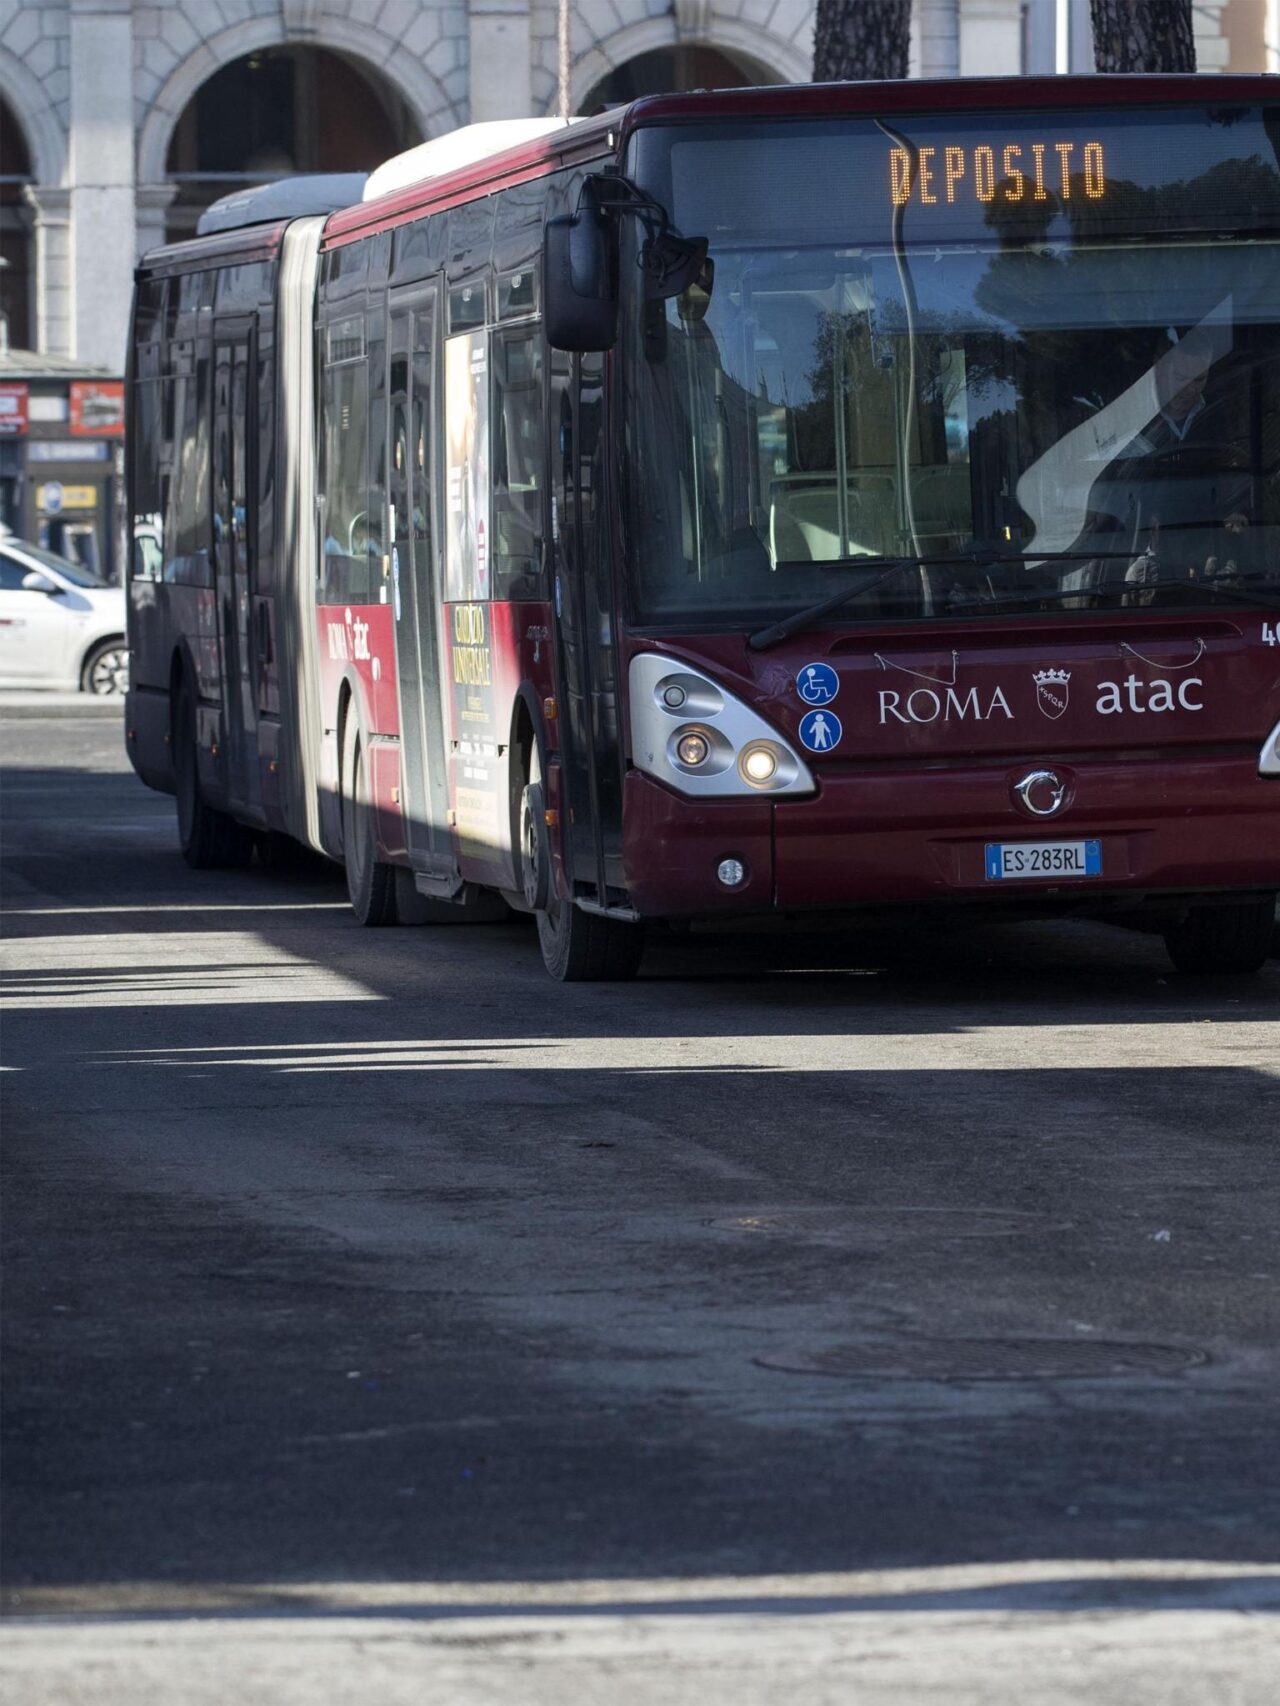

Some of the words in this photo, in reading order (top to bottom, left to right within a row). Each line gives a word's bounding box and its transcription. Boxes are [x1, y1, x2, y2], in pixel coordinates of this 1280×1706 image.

[890, 142, 1104, 204] DEPOSITO
[877, 686, 1015, 724] ROMA
[1096, 673, 1204, 715] atac
